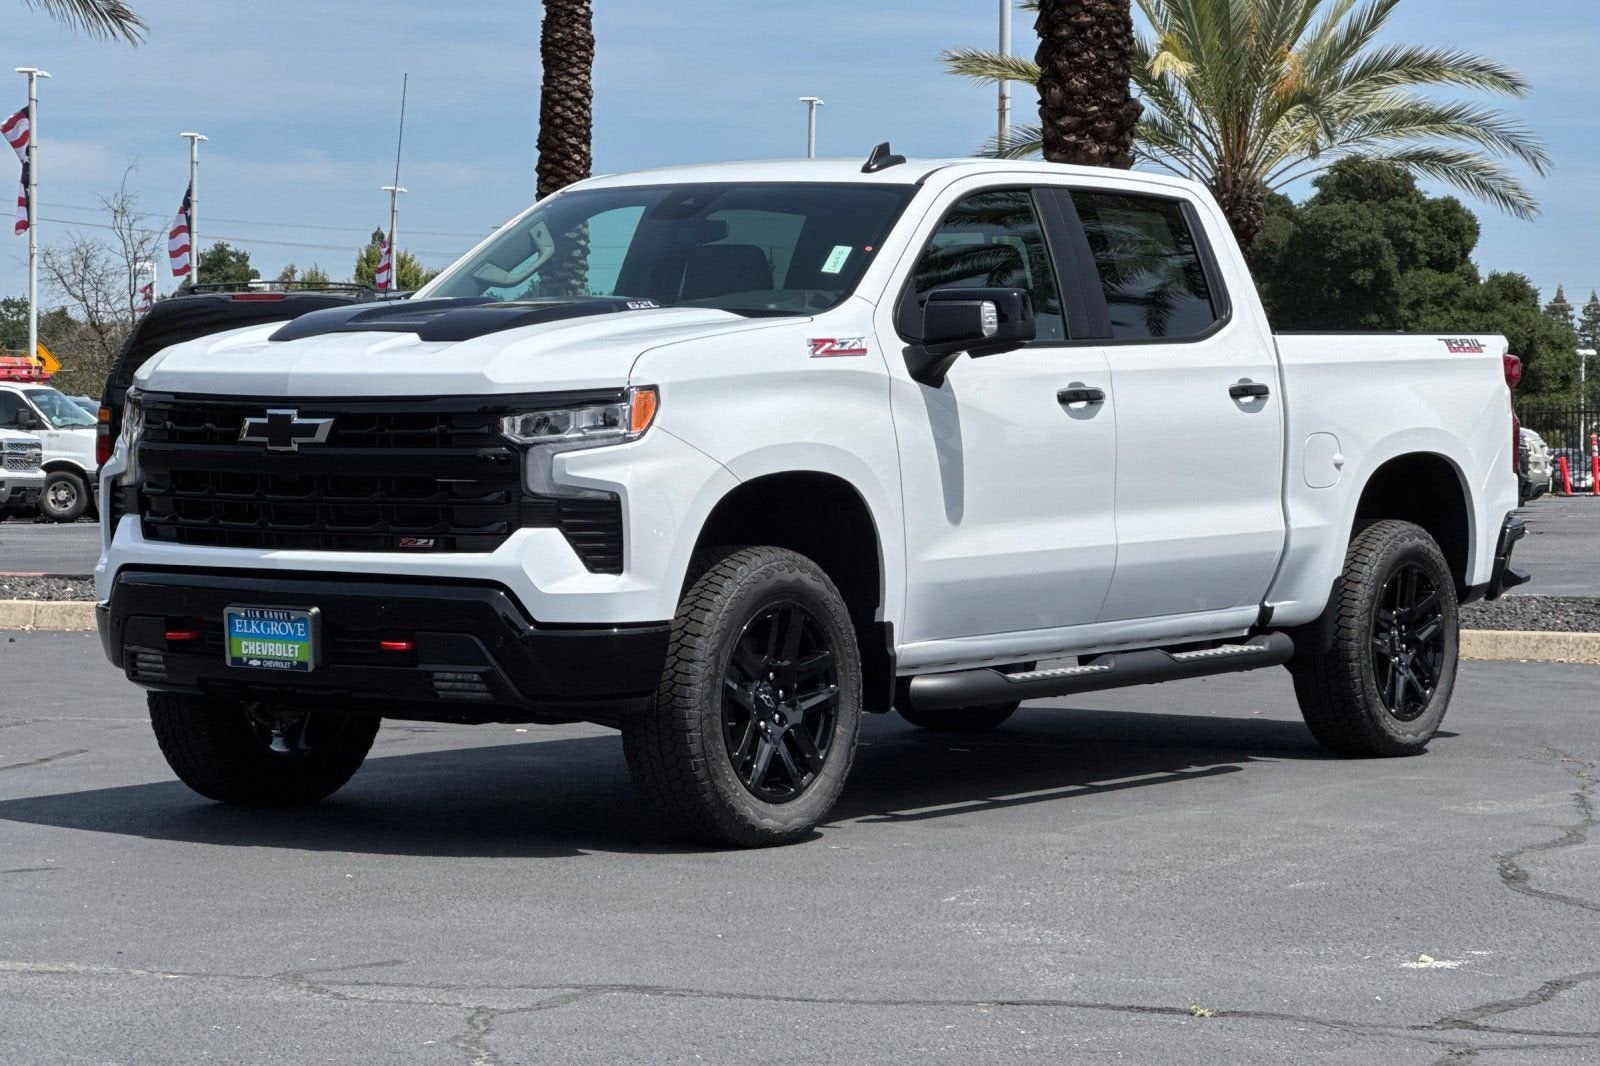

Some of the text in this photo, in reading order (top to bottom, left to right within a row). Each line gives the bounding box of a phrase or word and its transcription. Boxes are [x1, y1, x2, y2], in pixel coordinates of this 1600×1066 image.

[807, 337, 868, 358] Z71
[1437, 338, 1487, 347] TRAIL
[1448, 346, 1484, 354] BOSS
[400, 537, 435, 548] Z71
[247, 609, 289, 621] ELK GROVE
[241, 640, 300, 658] CHEVROLET
[262, 660, 291, 669] CHEVROLET
